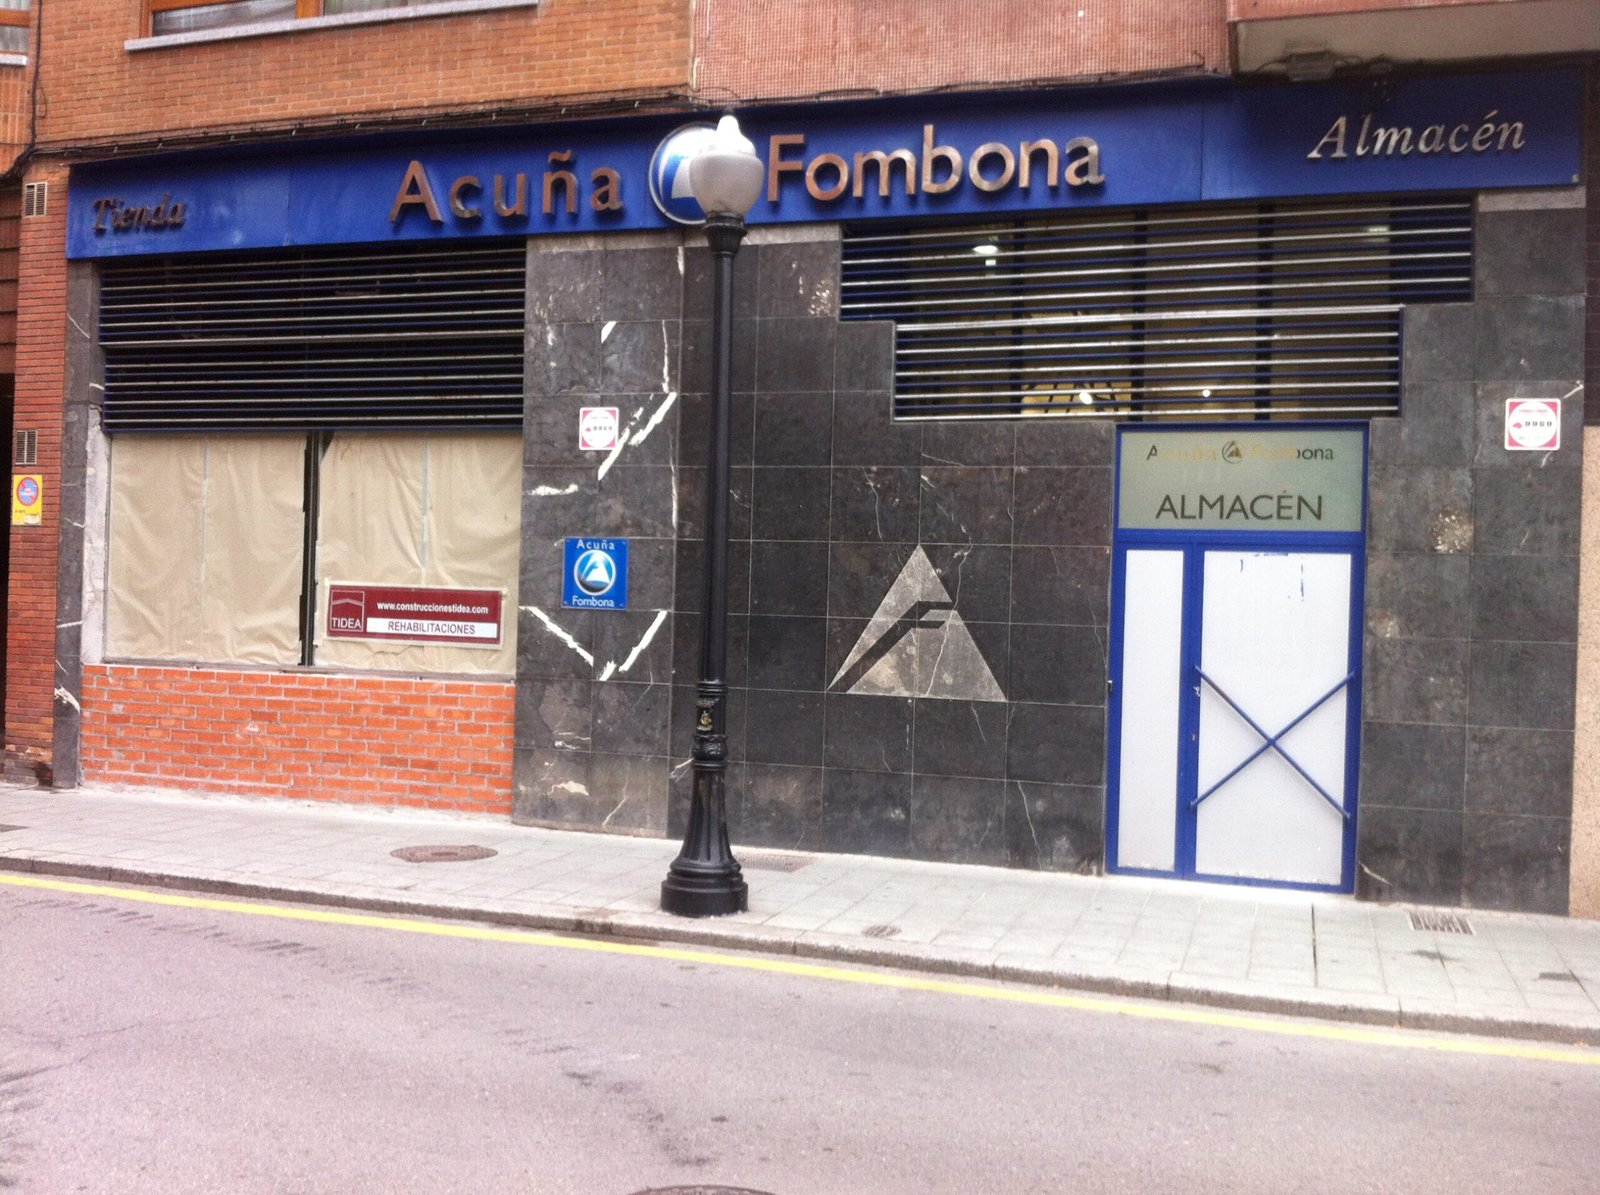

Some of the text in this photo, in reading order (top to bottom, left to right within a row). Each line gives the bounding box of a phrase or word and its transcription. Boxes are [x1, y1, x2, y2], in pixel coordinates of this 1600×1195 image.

[1307, 110, 1526, 159] Almacén
[389, 124, 1105, 222] Acuña Fombona
[93, 193, 185, 232] Tienda
[1155, 490, 1322, 521] ALMACÉN
[576, 539, 615, 551] Acuña
[376, 602, 489, 615] www.construccionestidea.com
[572, 595, 614, 608] Fombona
[331, 617, 362, 630] TIDEA
[387, 621, 476, 635] REHABILITACIONES
